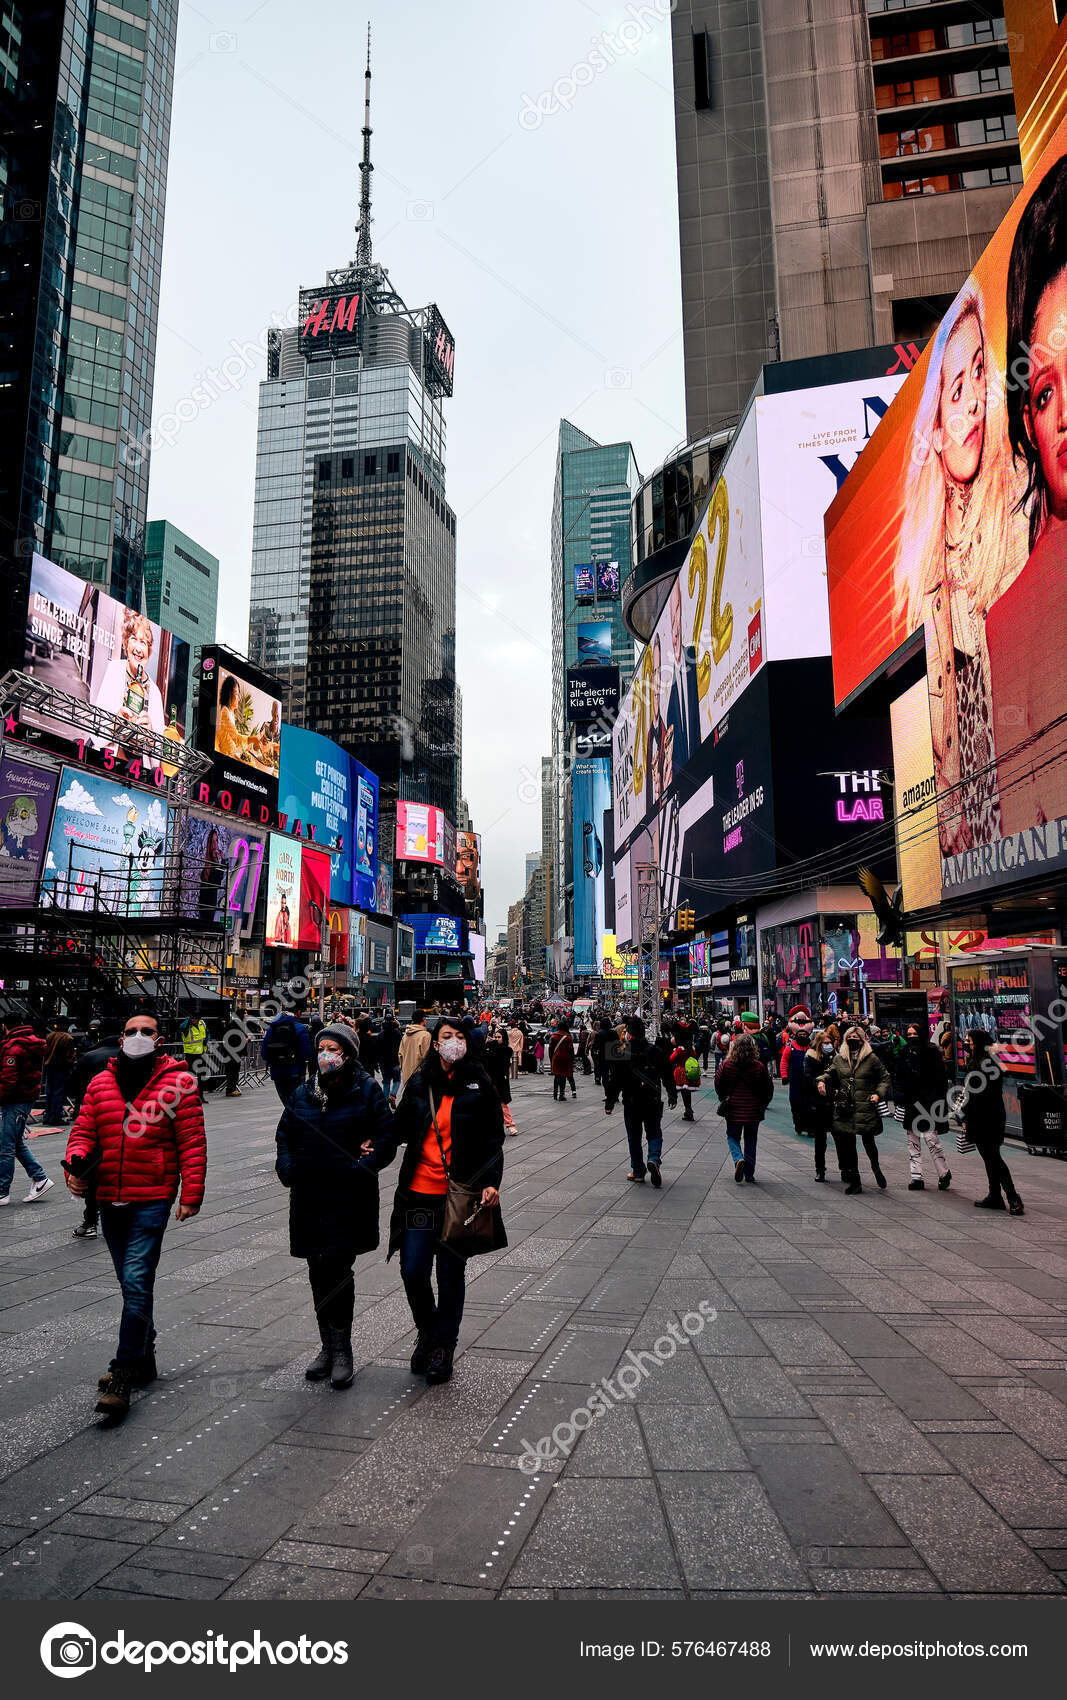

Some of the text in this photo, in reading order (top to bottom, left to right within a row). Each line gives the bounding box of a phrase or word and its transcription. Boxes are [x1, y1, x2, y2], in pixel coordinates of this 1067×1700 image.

[302, 294, 360, 337] H&M
[434, 328, 454, 380] H&M
[798, 435, 857, 449] TIMES SQUARE
[813, 428, 857, 440] LIVE FROM
[33, 592, 116, 651] CELEBRITY FREE
[31, 616, 64, 648] SINCE
[202, 672, 214, 681] LG
[569, 680, 587, 689] The
[569, 688, 617, 698] all-electric
[570, 697, 605, 708] Kia EV6
[315, 759, 327, 778] GET
[902, 775, 937, 809] amazon
[722, 785, 764, 833] THE LEADER IN 5G
[67, 815, 119, 835] WELCOME BACK
[278, 852, 293, 869] GIRL
[942, 823, 1049, 888] AMERICAN
[276, 868, 295, 884] NORTH
[730, 968, 750, 982] SEPHORA
